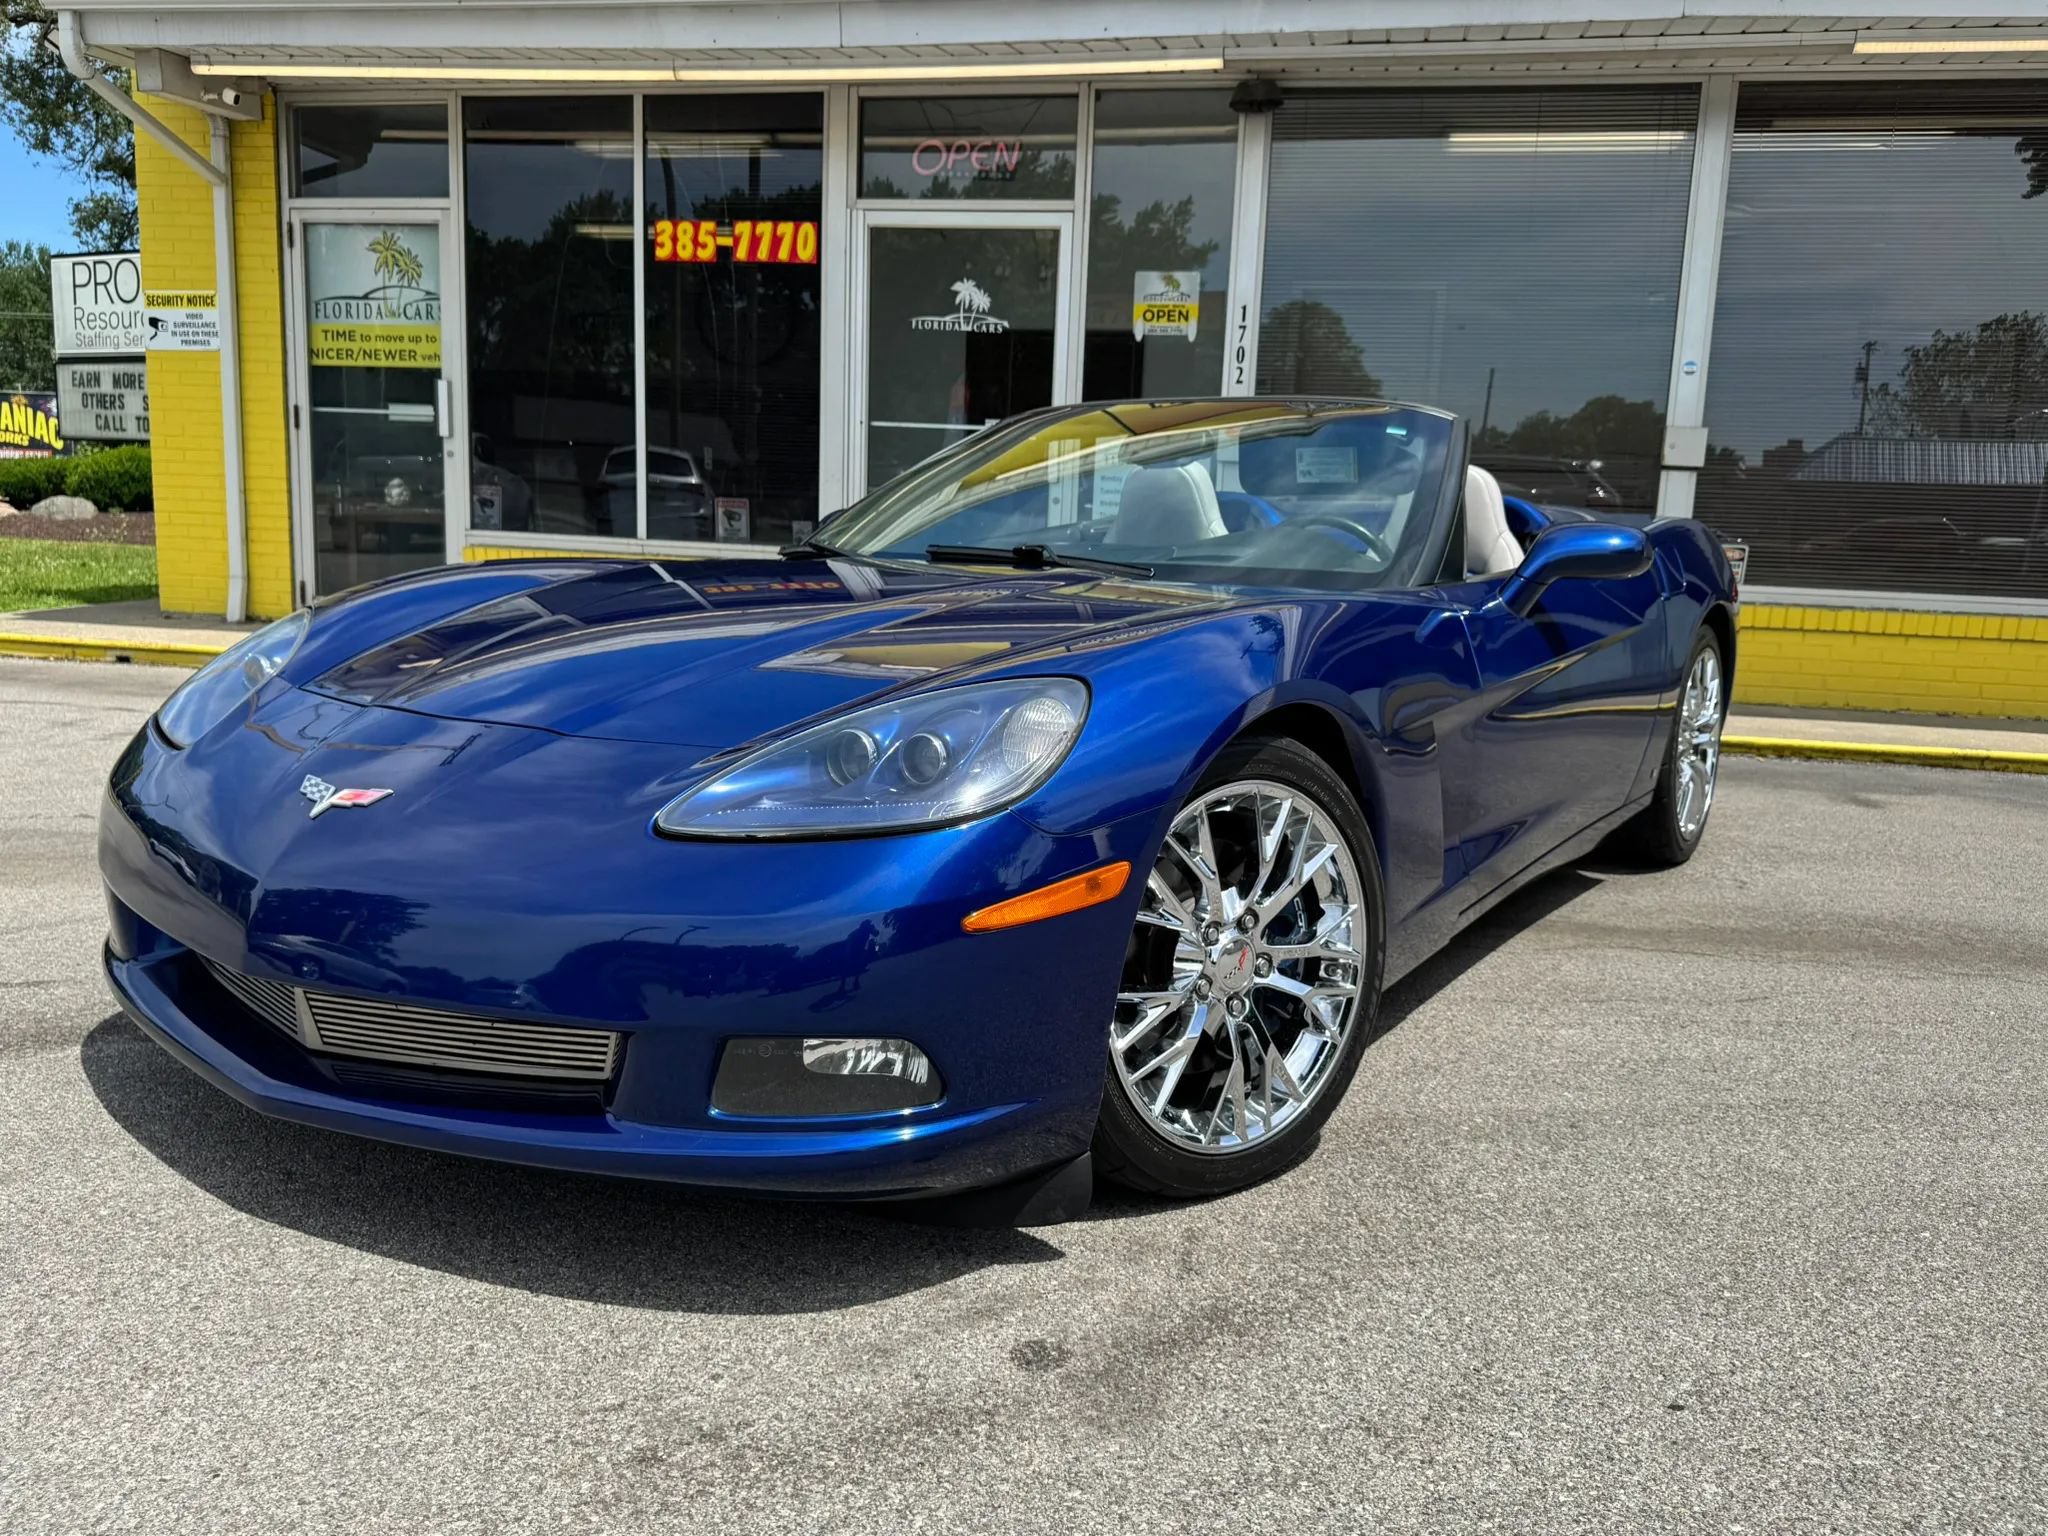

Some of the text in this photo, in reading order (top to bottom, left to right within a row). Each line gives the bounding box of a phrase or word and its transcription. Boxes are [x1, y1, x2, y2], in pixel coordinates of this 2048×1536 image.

[912, 139, 1022, 176] OPEN
[655, 220, 816, 262] 385-7770
[72, 258, 141, 305] PRO
[146, 294, 216, 307] SECURITY NOTICE
[315, 301, 384, 320] FLORIDA
[1143, 309, 1189, 322] OPEN
[173, 321, 216, 329] SURVEILLANCE
[191, 330, 200, 338] ON
[201, 330, 219, 338] THESE
[912, 320, 1003, 334] FLORIDA CARS
[75, 332, 120, 350] Staffing
[321, 329, 438, 345] TIME to move up to
[310, 347, 418, 362] NICER/NEWER
[72, 371, 145, 390] EARN MORE
[81, 392, 125, 411] OTHERS
[95, 413, 127, 432] CALL
